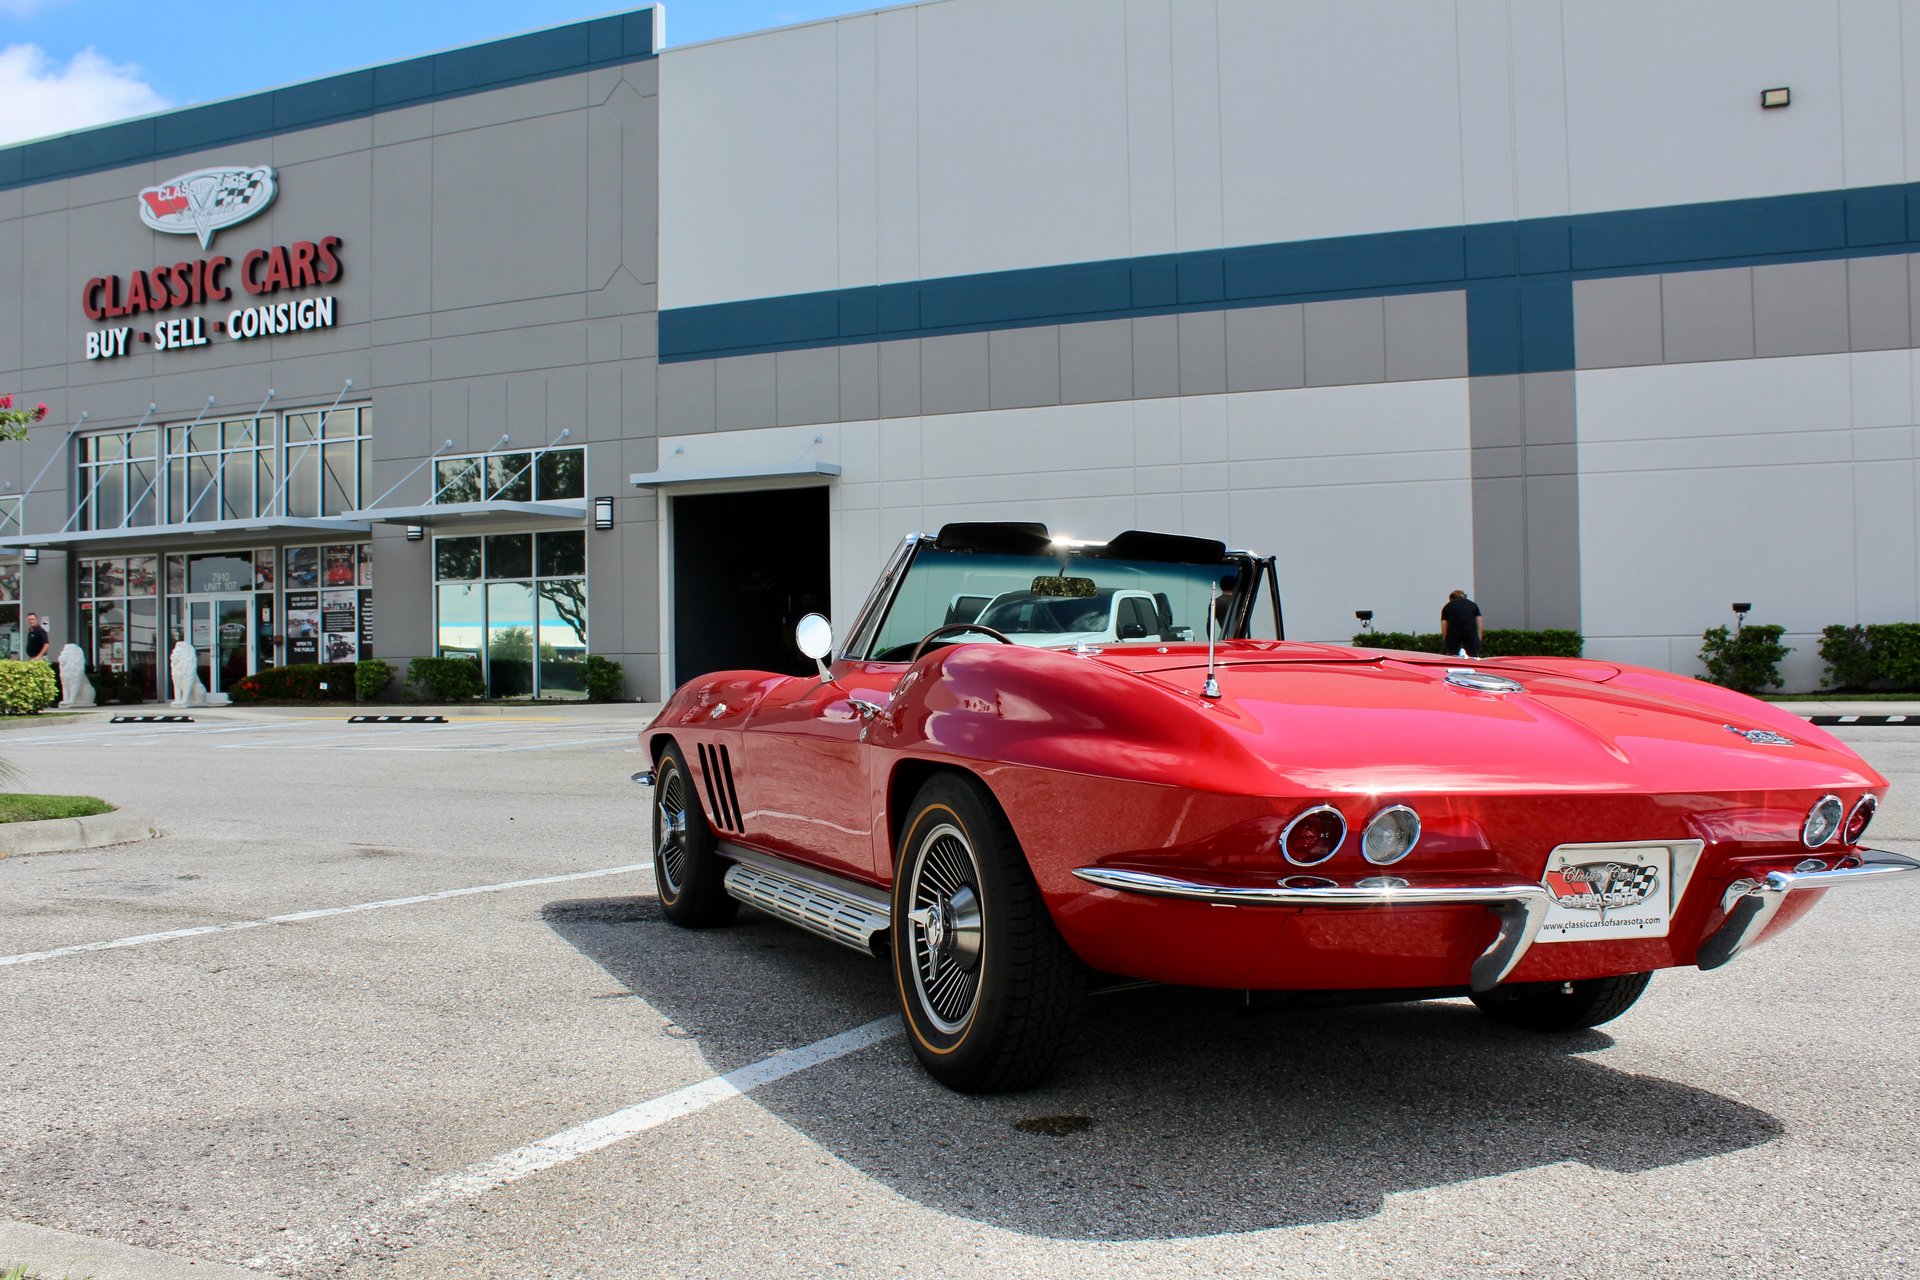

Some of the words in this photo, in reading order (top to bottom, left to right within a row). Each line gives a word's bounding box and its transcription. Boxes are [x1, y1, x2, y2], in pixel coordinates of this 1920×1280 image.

[83, 255, 231, 320] CLASSIC
[241, 236, 342, 295] CARS
[86, 326, 130, 360] BUY
[155, 316, 207, 350] SELL
[227, 296, 335, 340] CONSIGN
[204, 582, 221, 592] UNIT
[224, 581, 237, 591] 107
[211, 572, 230, 582] 7910
[1559, 863, 1602, 884] Classic
[1562, 889, 1641, 909] SARASOTA
[1542, 917, 1661, 931] www.classiccarsofsarasota.com
